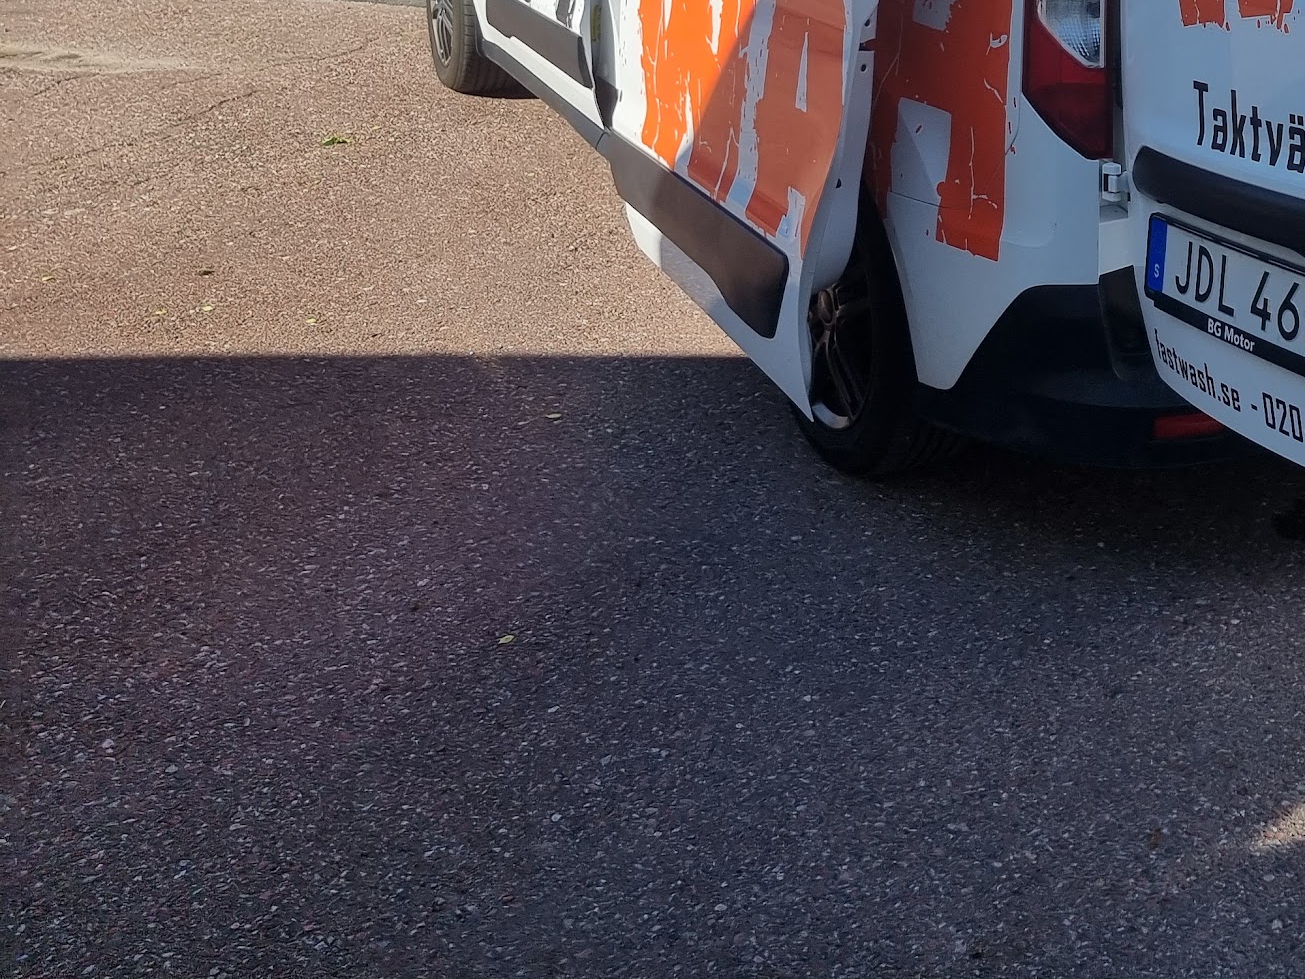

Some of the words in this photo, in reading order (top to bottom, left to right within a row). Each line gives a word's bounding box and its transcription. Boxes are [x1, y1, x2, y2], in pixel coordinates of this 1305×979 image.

[1153, 262, 1160, 279] S
[1174, 240, 1235, 318] JDL
[1207, 318, 1222, 337] BG
[1224, 325, 1256, 353] Motor
[1153, 328, 1241, 413] fastwash.se
